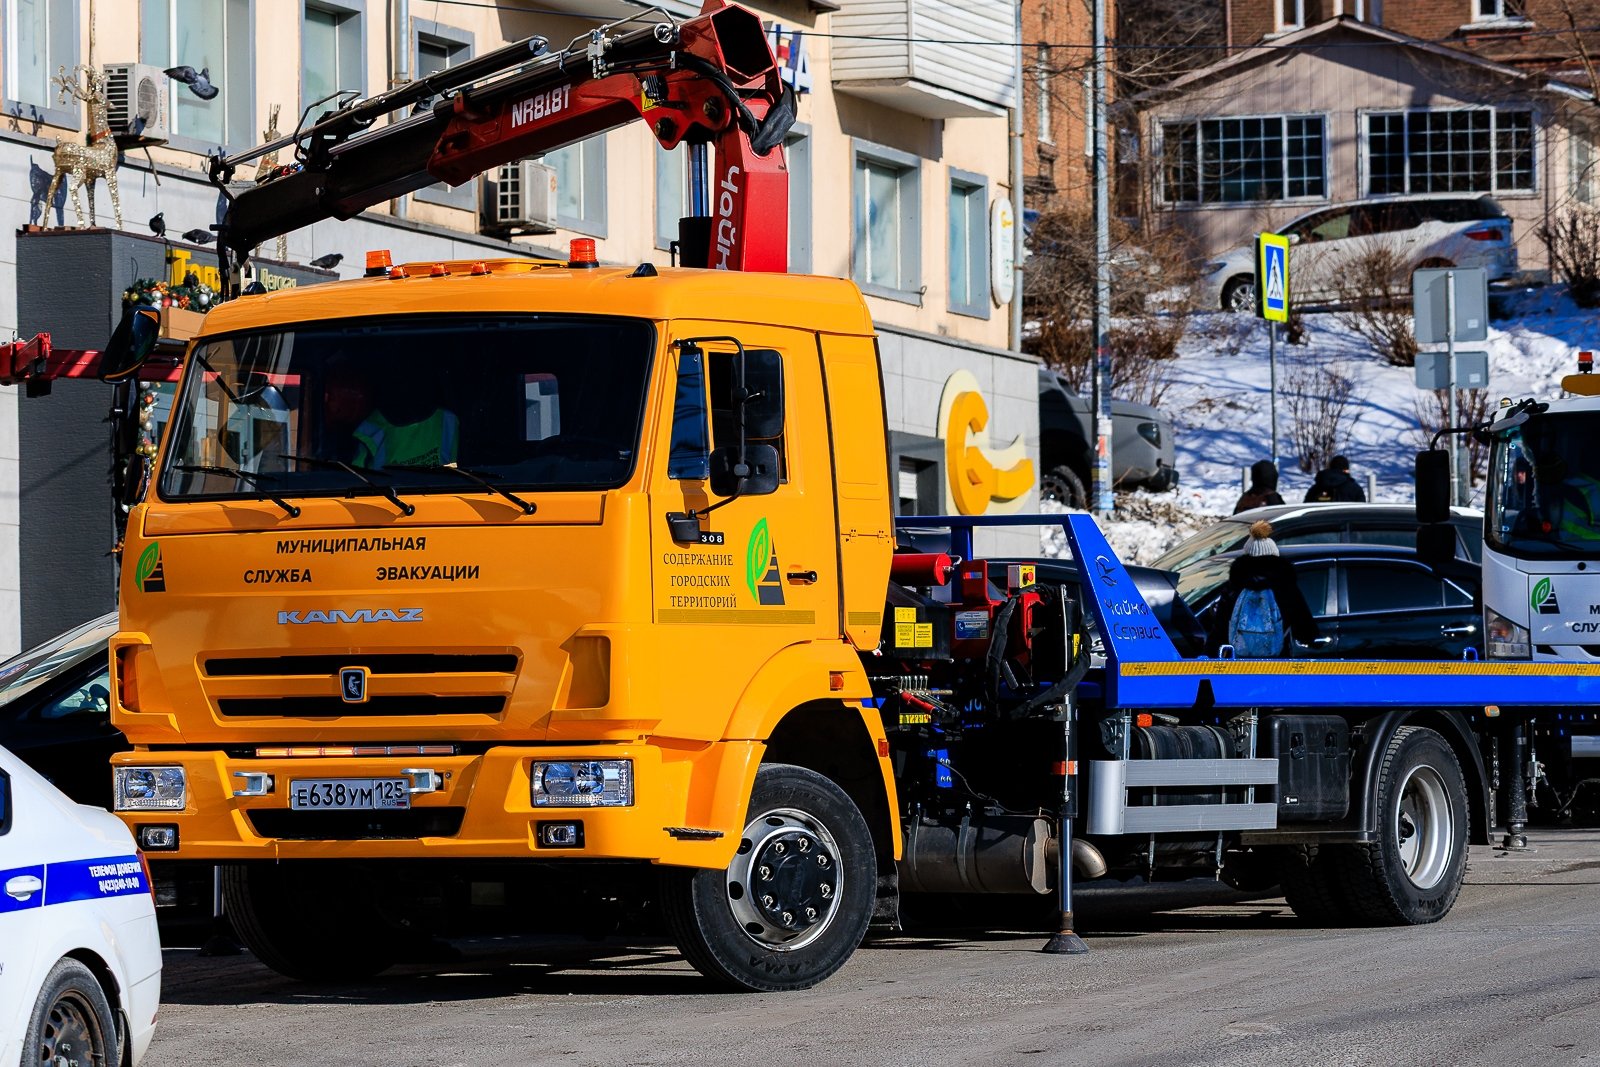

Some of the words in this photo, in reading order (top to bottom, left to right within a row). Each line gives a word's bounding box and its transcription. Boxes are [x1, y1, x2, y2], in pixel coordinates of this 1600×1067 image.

[511, 84, 572, 128] NR818T
[276, 536, 426, 554] МУНИЦИПАЛЬНАЯ
[701, 534, 723, 543] 308
[663, 553, 734, 566] СОДЕРЖАНИЕ
[243, 568, 313, 584] СЛУЖБА
[375, 565, 480, 581] ЭВАКУАЦИИ
[671, 575, 731, 588] ГОРОДСКИХ
[670, 593, 737, 608] ТЕРРИТОРИЙ
[278, 608, 423, 624] KAMAZ
[1571, 622, 1600, 633] СЛУ
[375, 782, 403, 800] 125
